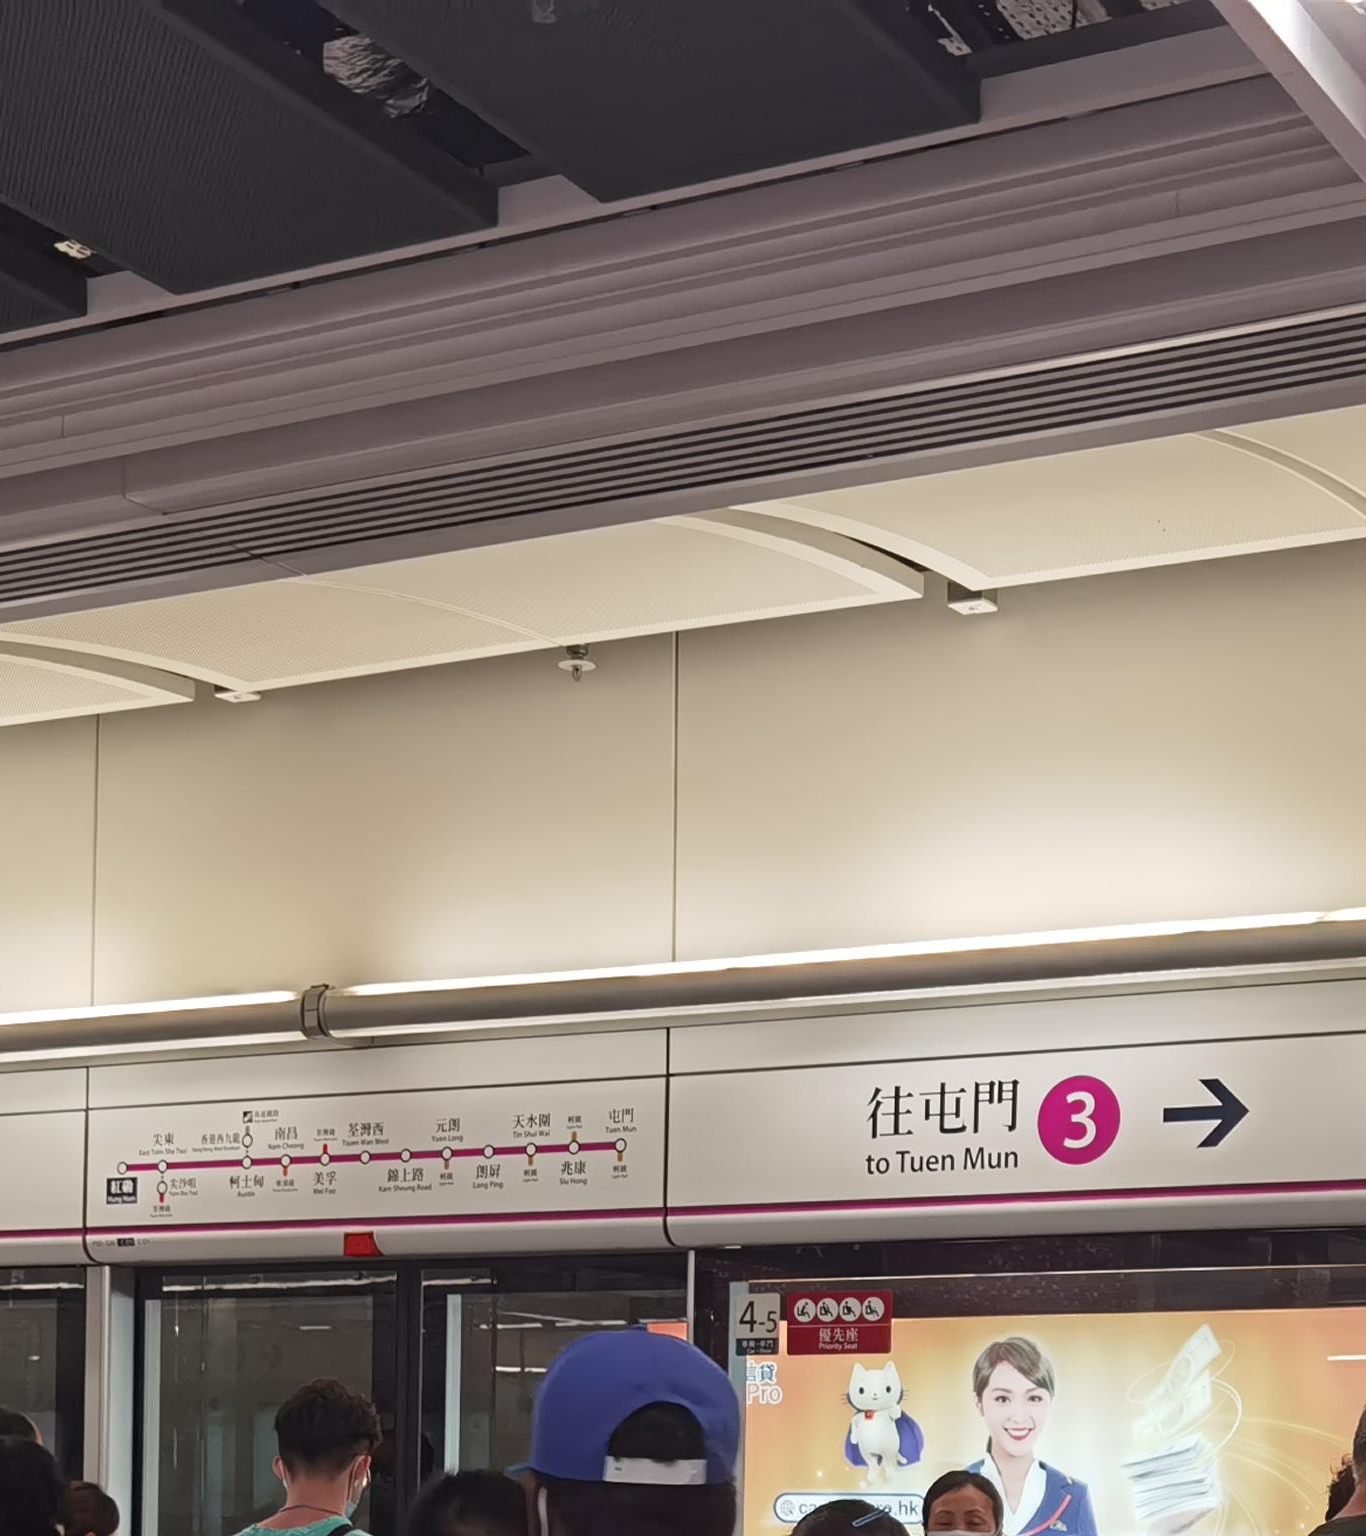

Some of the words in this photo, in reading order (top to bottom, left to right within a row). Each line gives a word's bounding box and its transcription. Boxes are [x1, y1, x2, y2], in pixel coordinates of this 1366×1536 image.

[866, 1079, 1020, 1139] 往屯門
[1063, 1091, 1097, 1149] 3
[866, 1153, 890, 1176] to
[896, 1150, 955, 1174] Tuen
[963, 1147, 1019, 1170] Mun
[739, 1301, 777, 1334] 4-5
[819, 1342, 843, 1351] Priority
[844, 1342, 858, 1350] Seat
[747, 1383, 781, 1401] Pro
